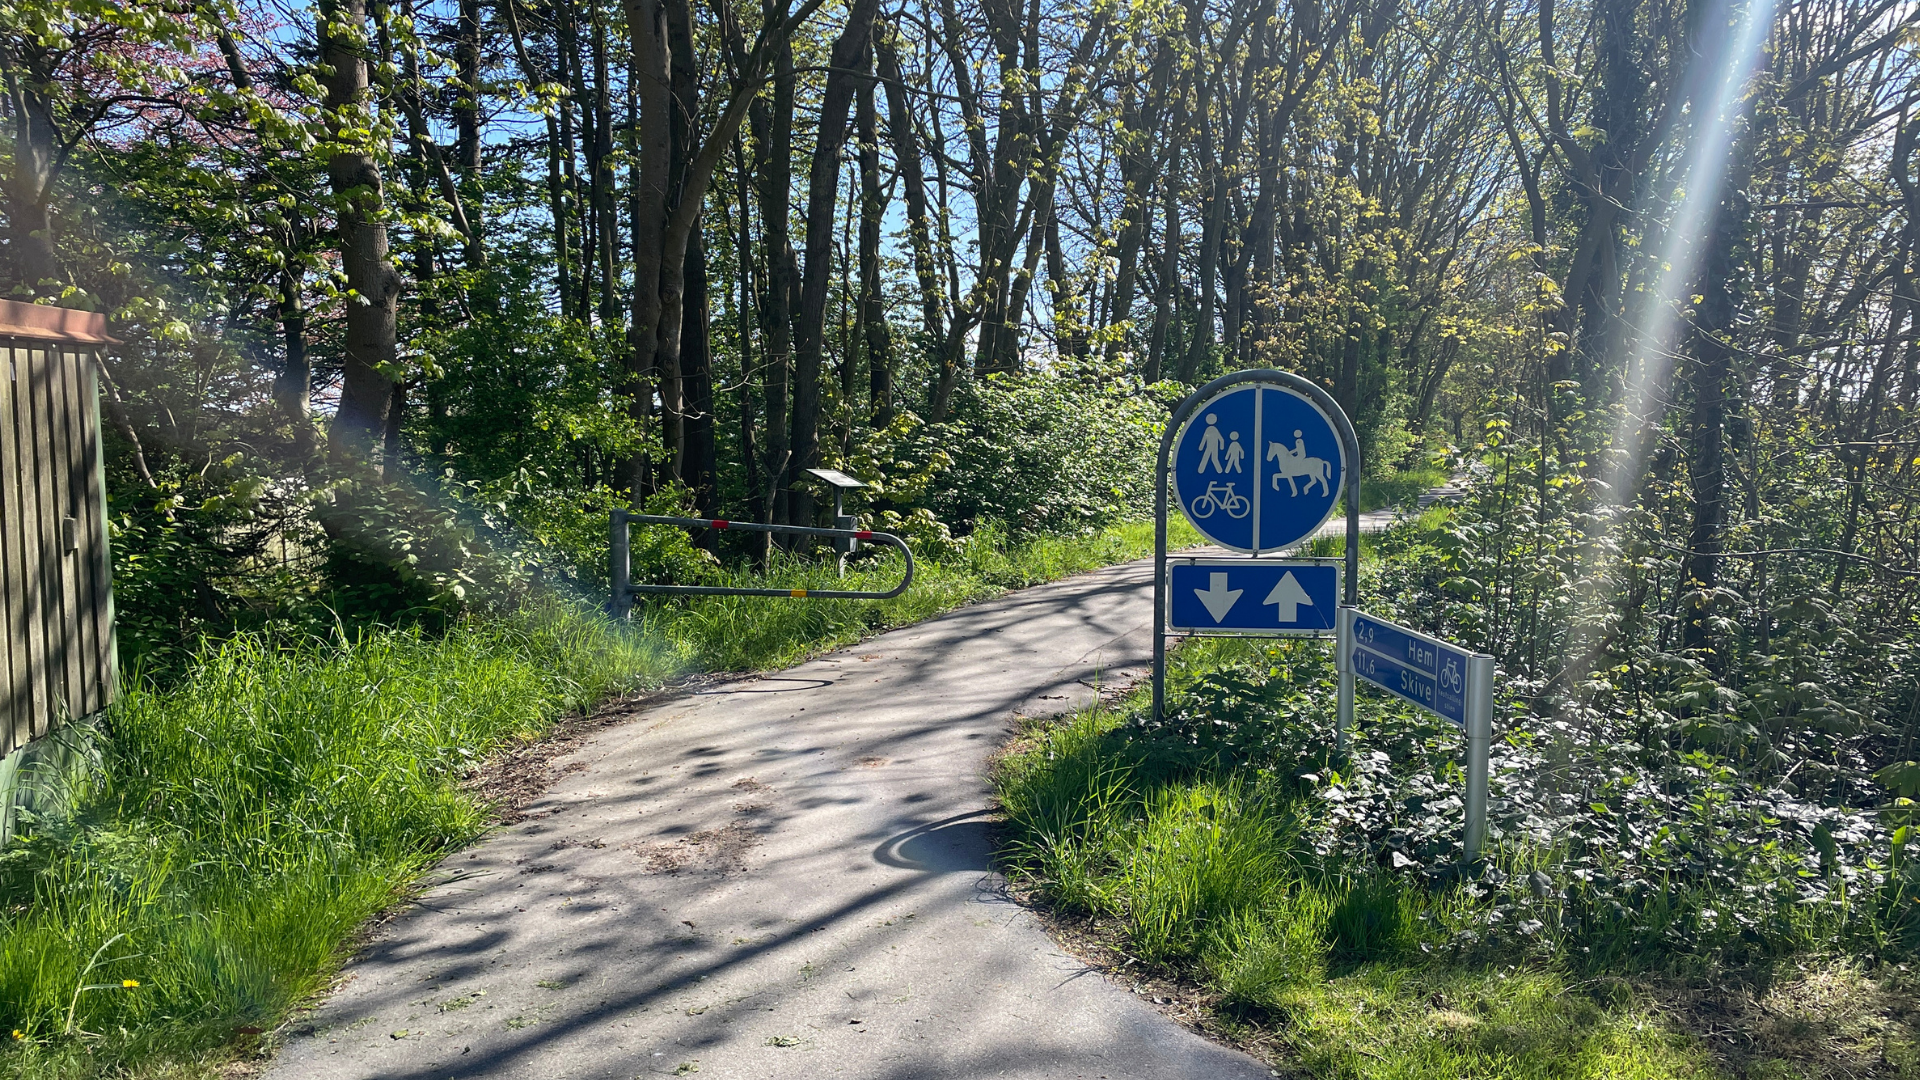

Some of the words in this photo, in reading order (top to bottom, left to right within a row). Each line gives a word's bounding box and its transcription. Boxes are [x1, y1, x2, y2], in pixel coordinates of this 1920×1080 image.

[1358, 621, 1374, 644] 2,9
[1408, 639, 1433, 668] Hem
[1358, 651, 1375, 675] 11,6
[1401, 670, 1432, 702] Skive
